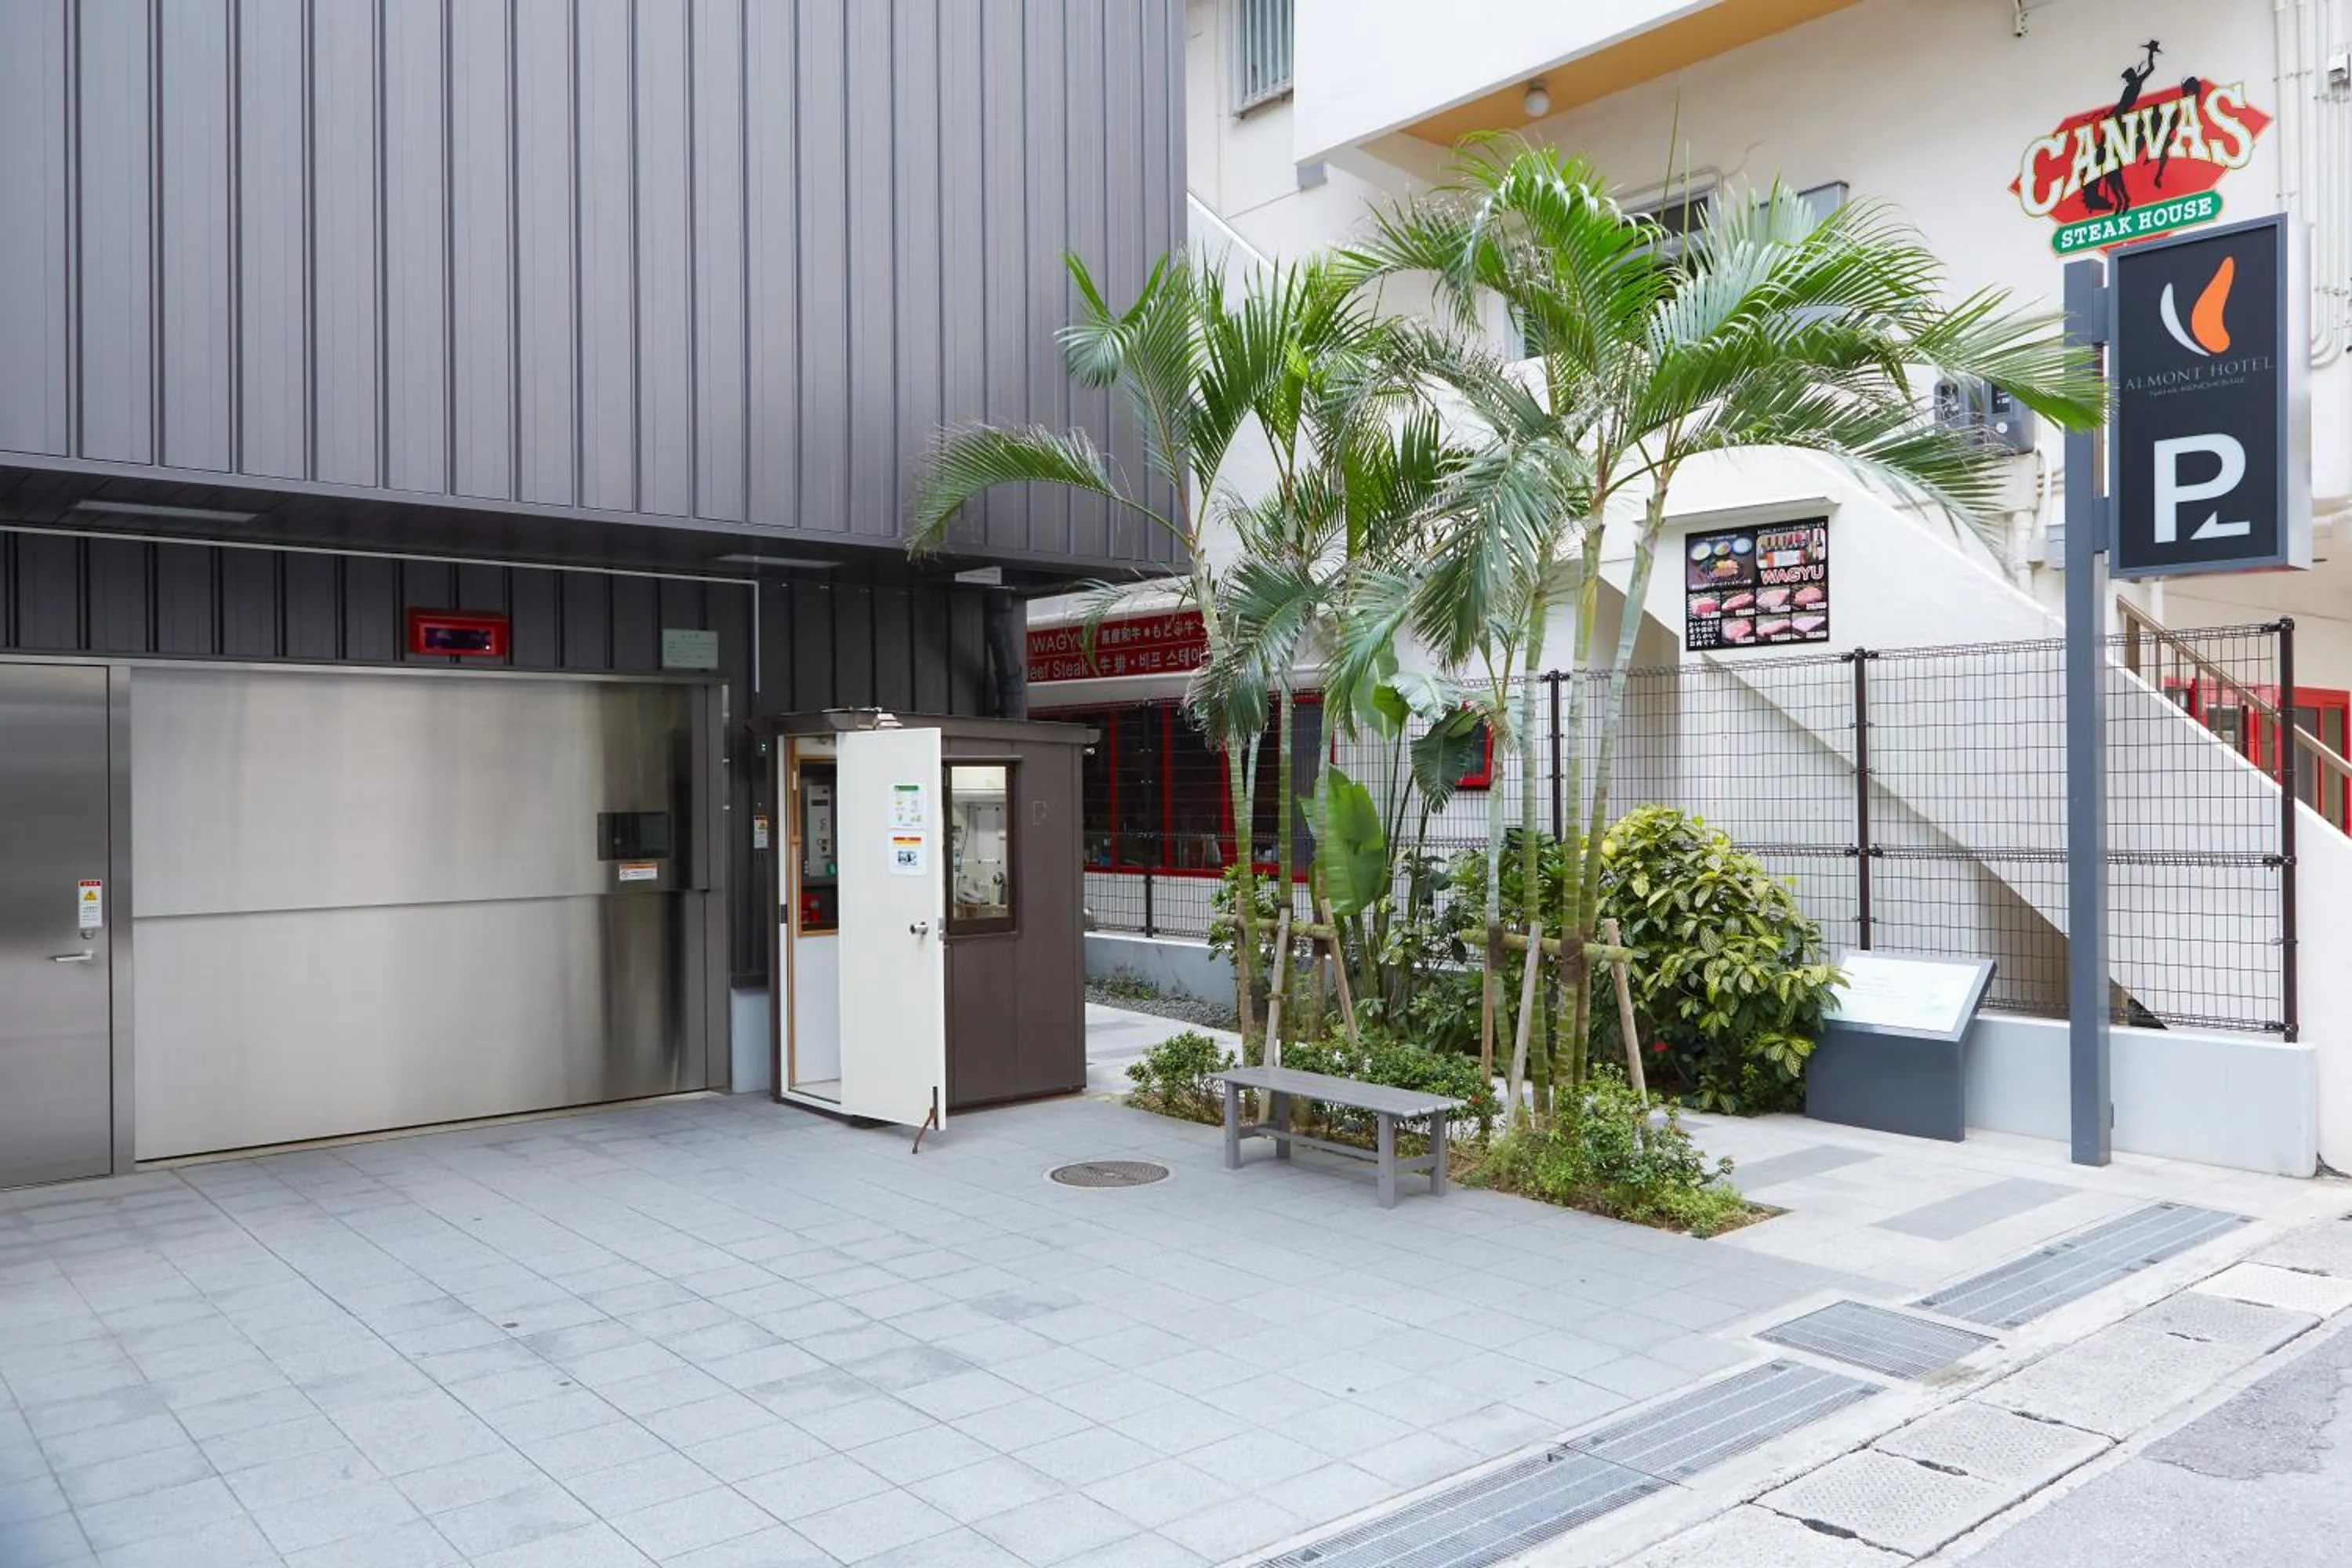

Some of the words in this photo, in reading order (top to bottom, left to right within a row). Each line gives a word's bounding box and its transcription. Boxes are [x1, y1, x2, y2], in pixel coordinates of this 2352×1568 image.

[2019, 81, 2254, 218] CANVAS
[2061, 216, 2132, 248] STEAK
[2139, 196, 2212, 232] HOUSE
[2125, 365, 2204, 390] ALMONT
[2209, 355, 2278, 378] HOTEL
[2154, 433, 2246, 543] P
[1760, 564, 1824, 585] WAGYU
[1028, 661, 1049, 680] eef
[1053, 658, 1088, 678] Steak
[1167, 646, 1203, 667] 스테이
